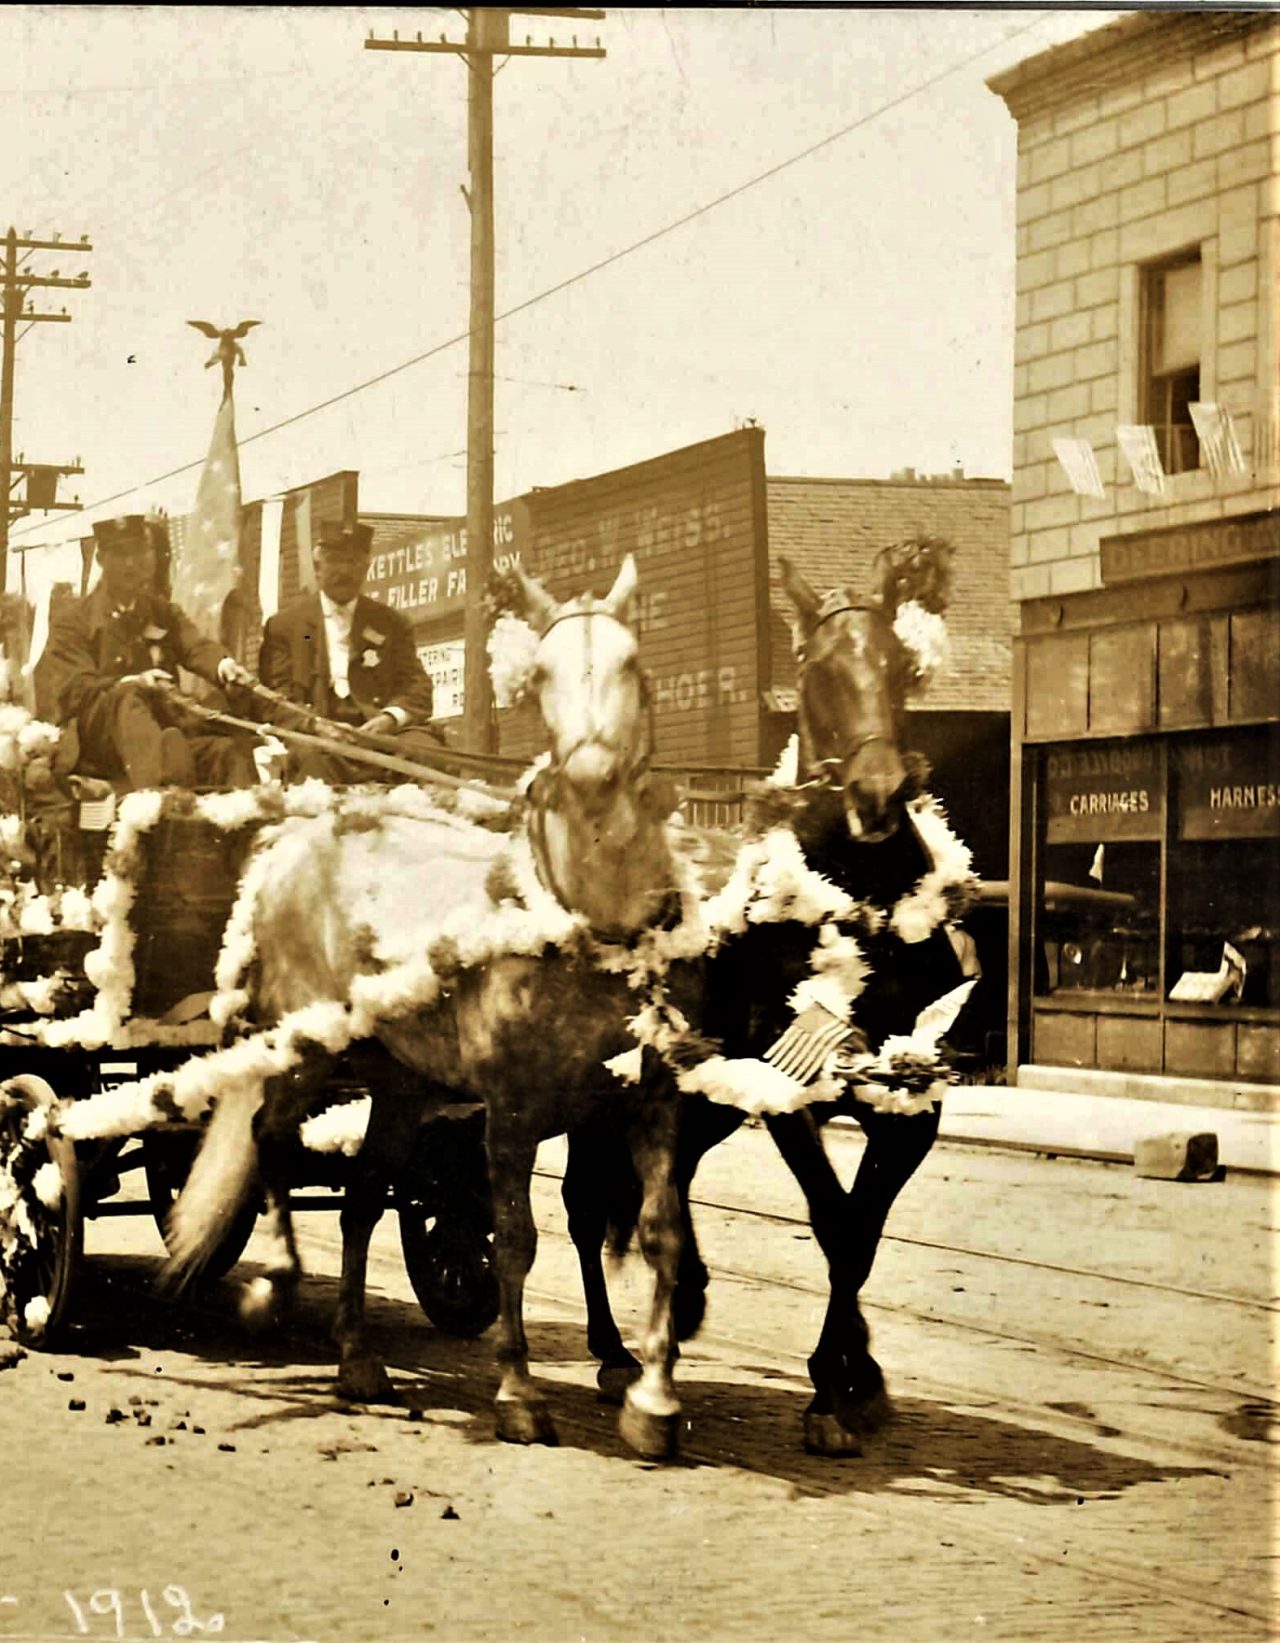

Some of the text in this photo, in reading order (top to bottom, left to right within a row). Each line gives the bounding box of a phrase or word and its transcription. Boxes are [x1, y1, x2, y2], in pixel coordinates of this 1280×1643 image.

[366, 542, 433, 582] KETTLES
[387, 577, 438, 611] FILLER
[1070, 789, 1149, 815] CARRIAGES
